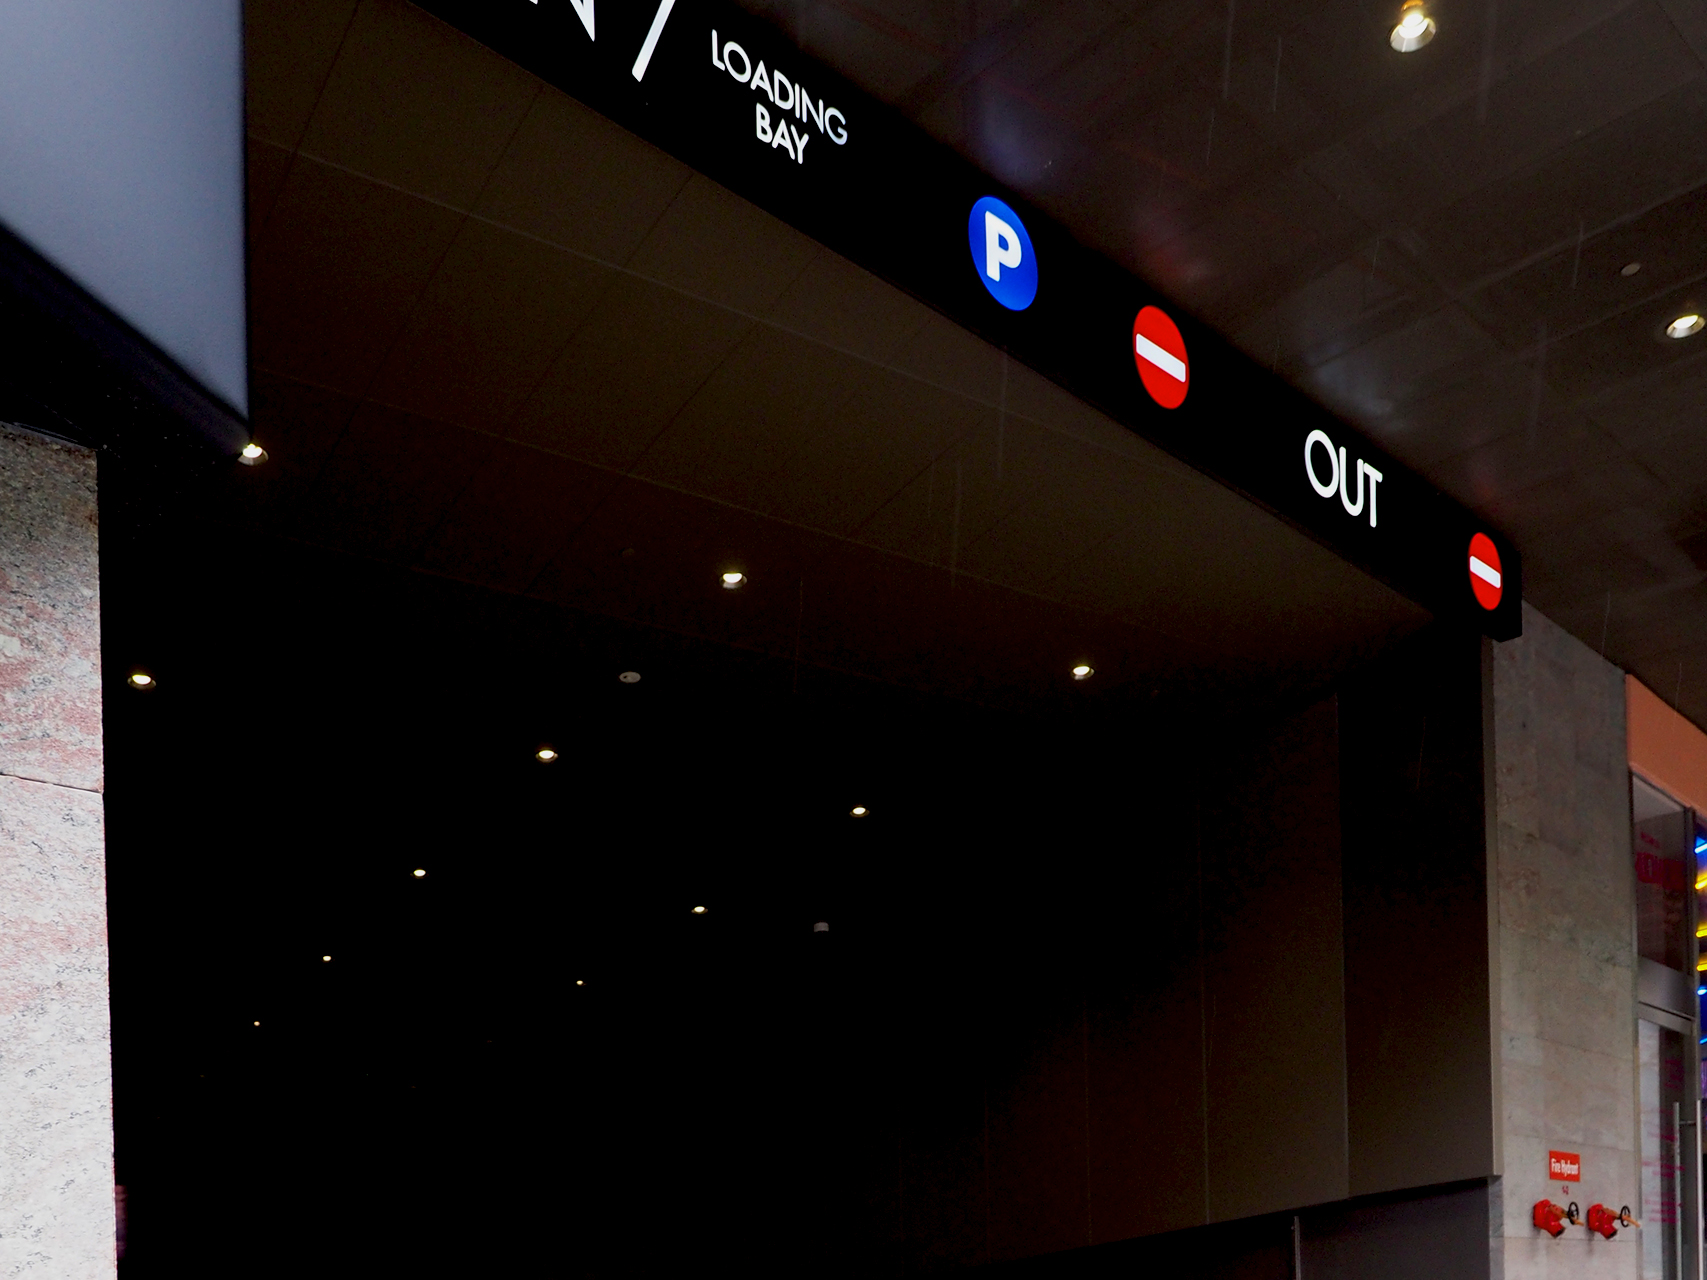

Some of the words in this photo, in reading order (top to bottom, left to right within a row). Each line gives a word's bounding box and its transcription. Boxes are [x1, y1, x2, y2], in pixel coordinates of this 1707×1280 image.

[711, 29, 848, 145] LOADING
[755, 102, 810, 165] BAY
[984, 210, 1022, 282] P
[1304, 429, 1383, 528] OUT
[1551, 1158, 1561, 1173] Fire
